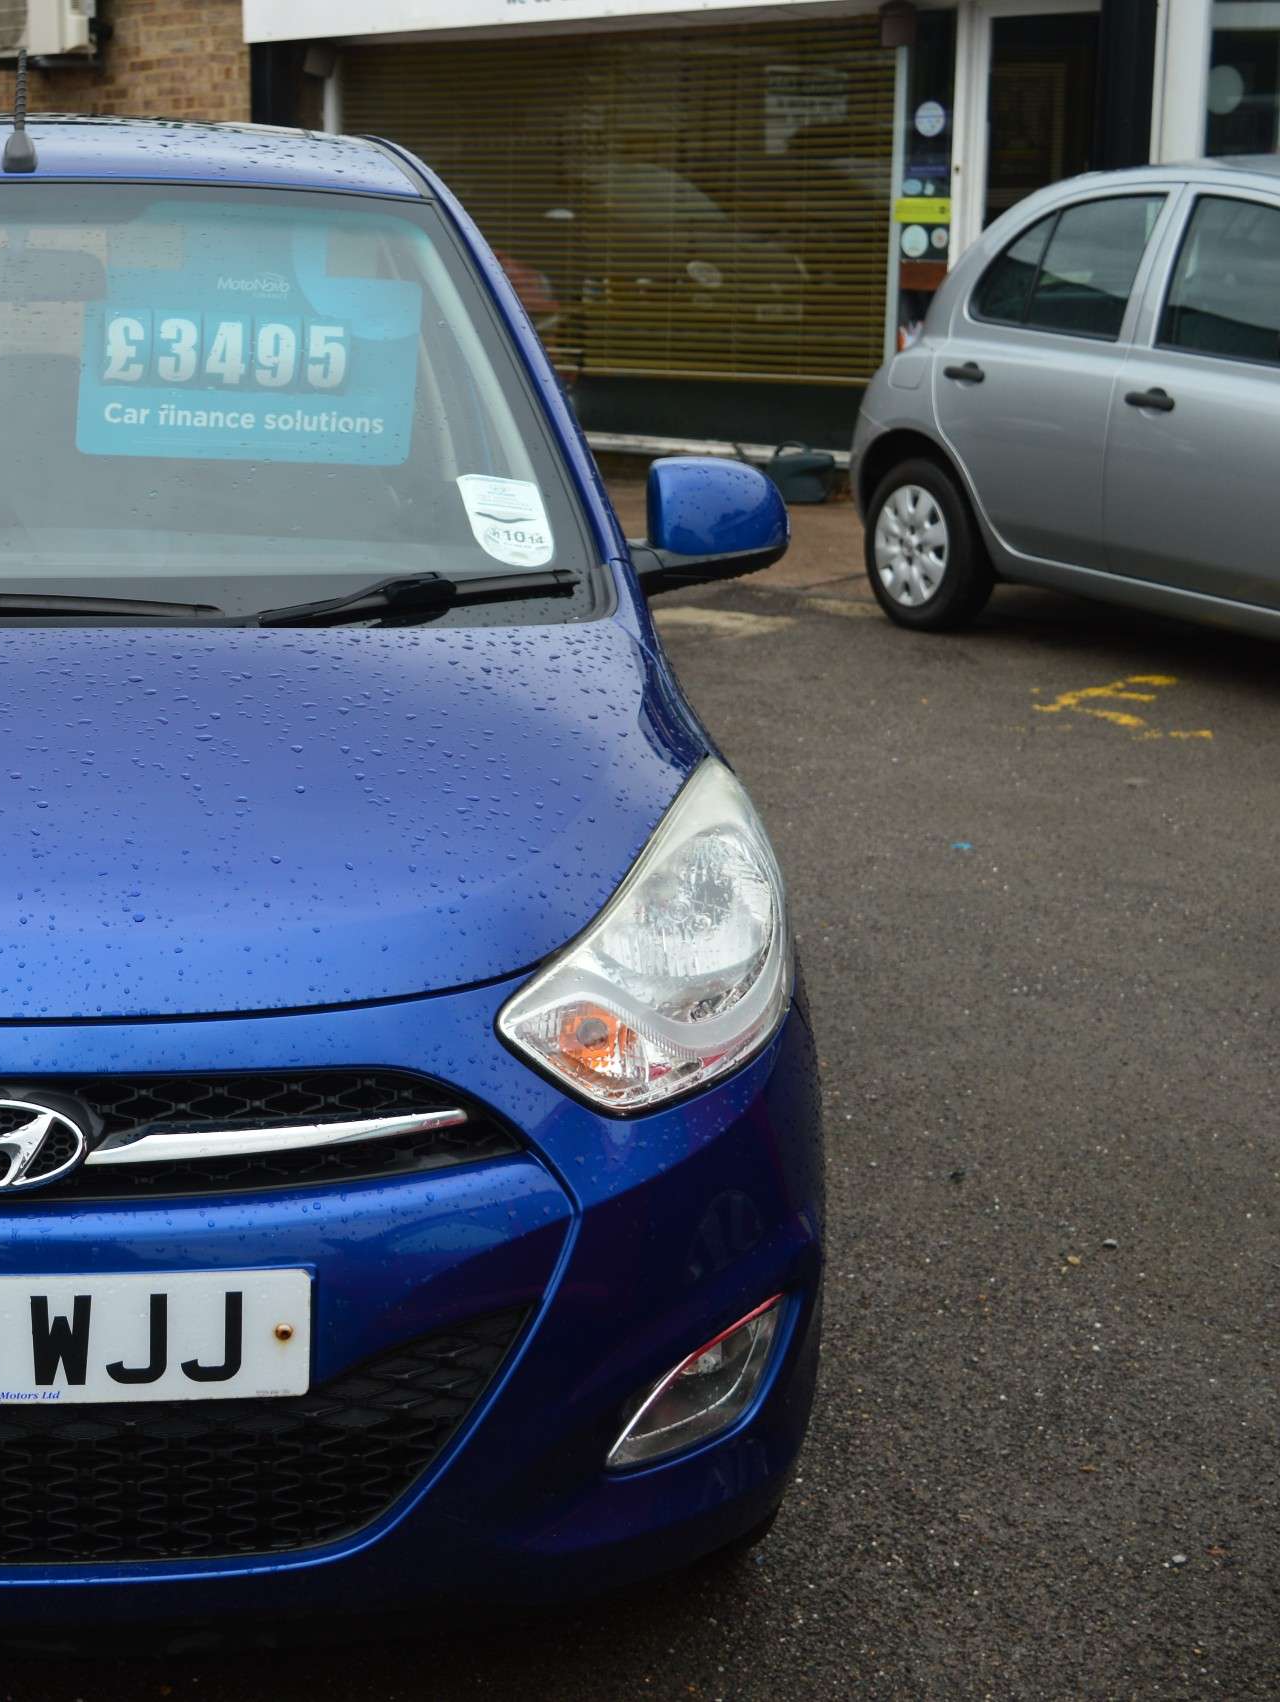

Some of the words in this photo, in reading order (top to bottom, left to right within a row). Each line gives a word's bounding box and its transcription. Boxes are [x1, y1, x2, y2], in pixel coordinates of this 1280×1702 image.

[104, 317, 347, 388] £3495
[104, 403, 150, 425] Car
[158, 404, 256, 429] finance
[264, 410, 385, 434] solutions
[30, 1291, 243, 1386] WJJ
[42, 1390, 61, 1400] Ltd
